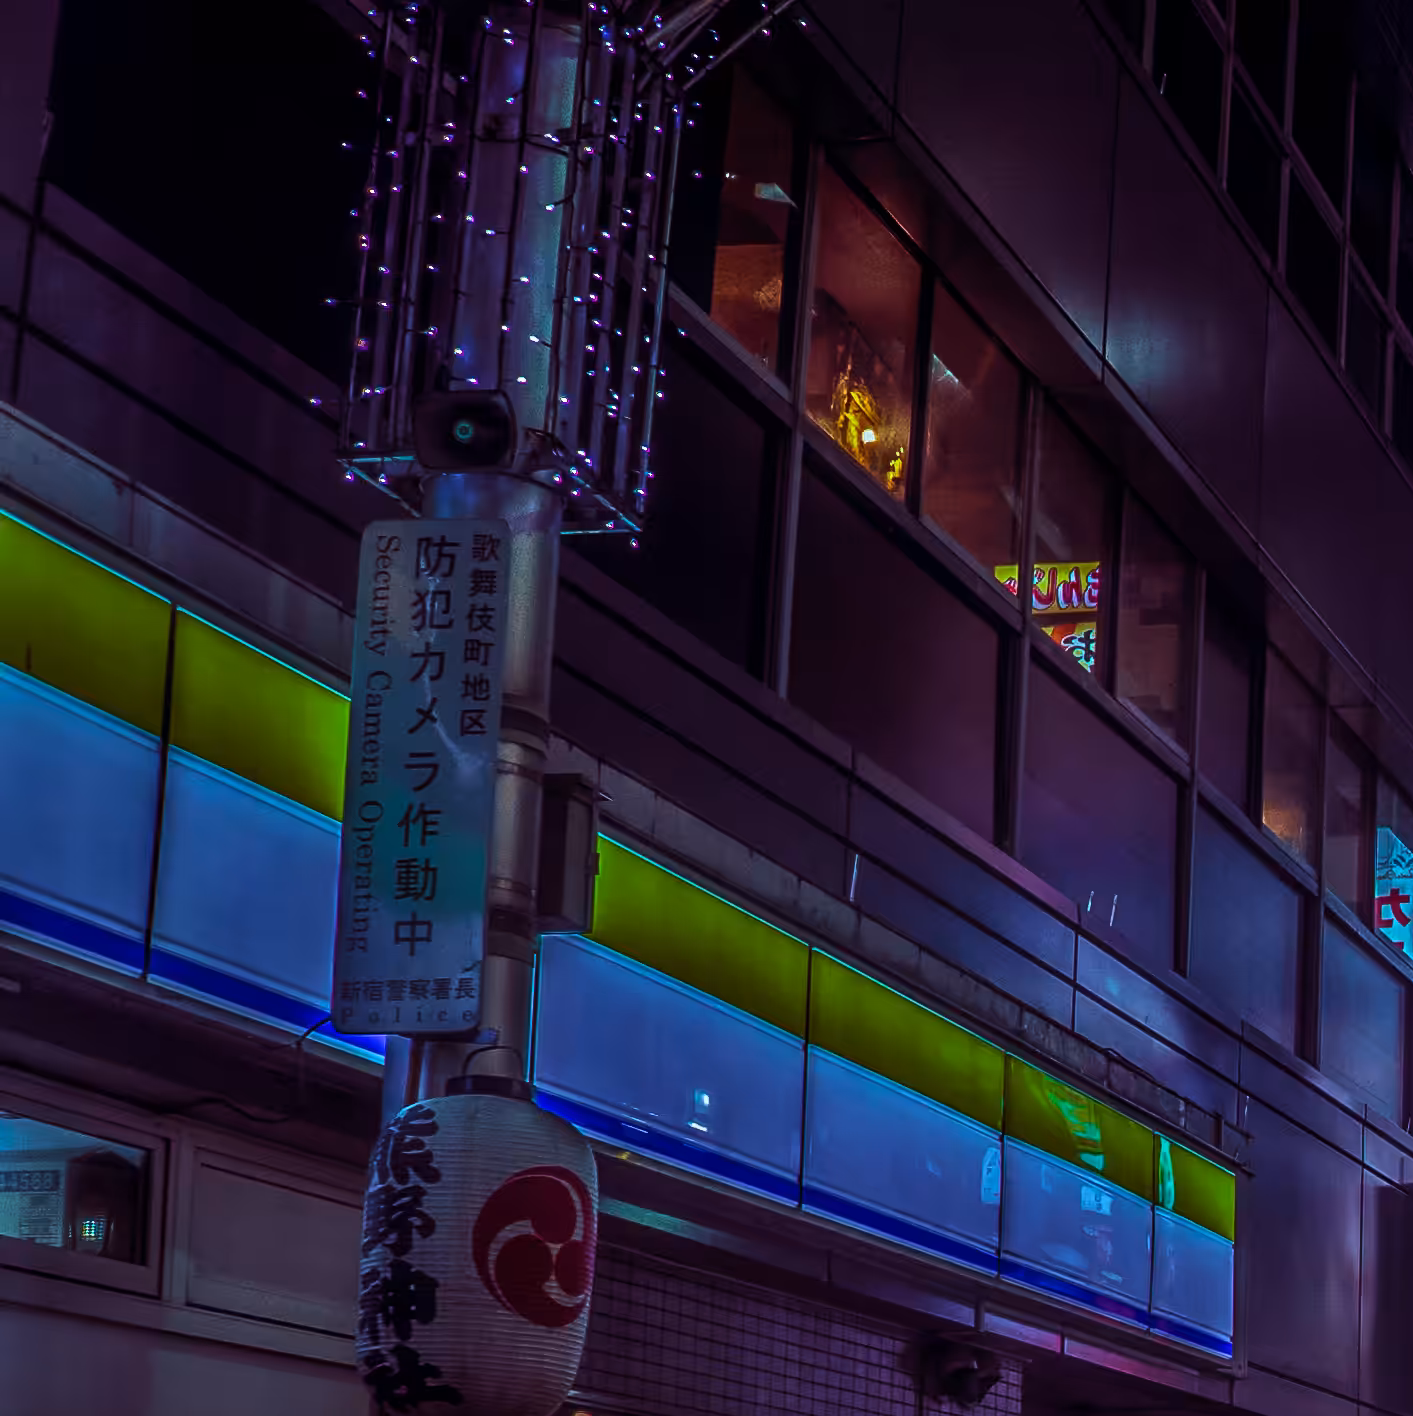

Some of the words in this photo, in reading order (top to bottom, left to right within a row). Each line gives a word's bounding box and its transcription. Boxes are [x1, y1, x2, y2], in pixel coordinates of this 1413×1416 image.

[363, 535, 401, 658] Security
[458, 533, 500, 737] 歌舞伎町地区
[358, 669, 394, 787] Camera
[392, 534, 461, 958] 防犯カメラ作動中
[344, 799, 385, 955] Operating
[340, 977, 477, 1001] 新宿警察署長
